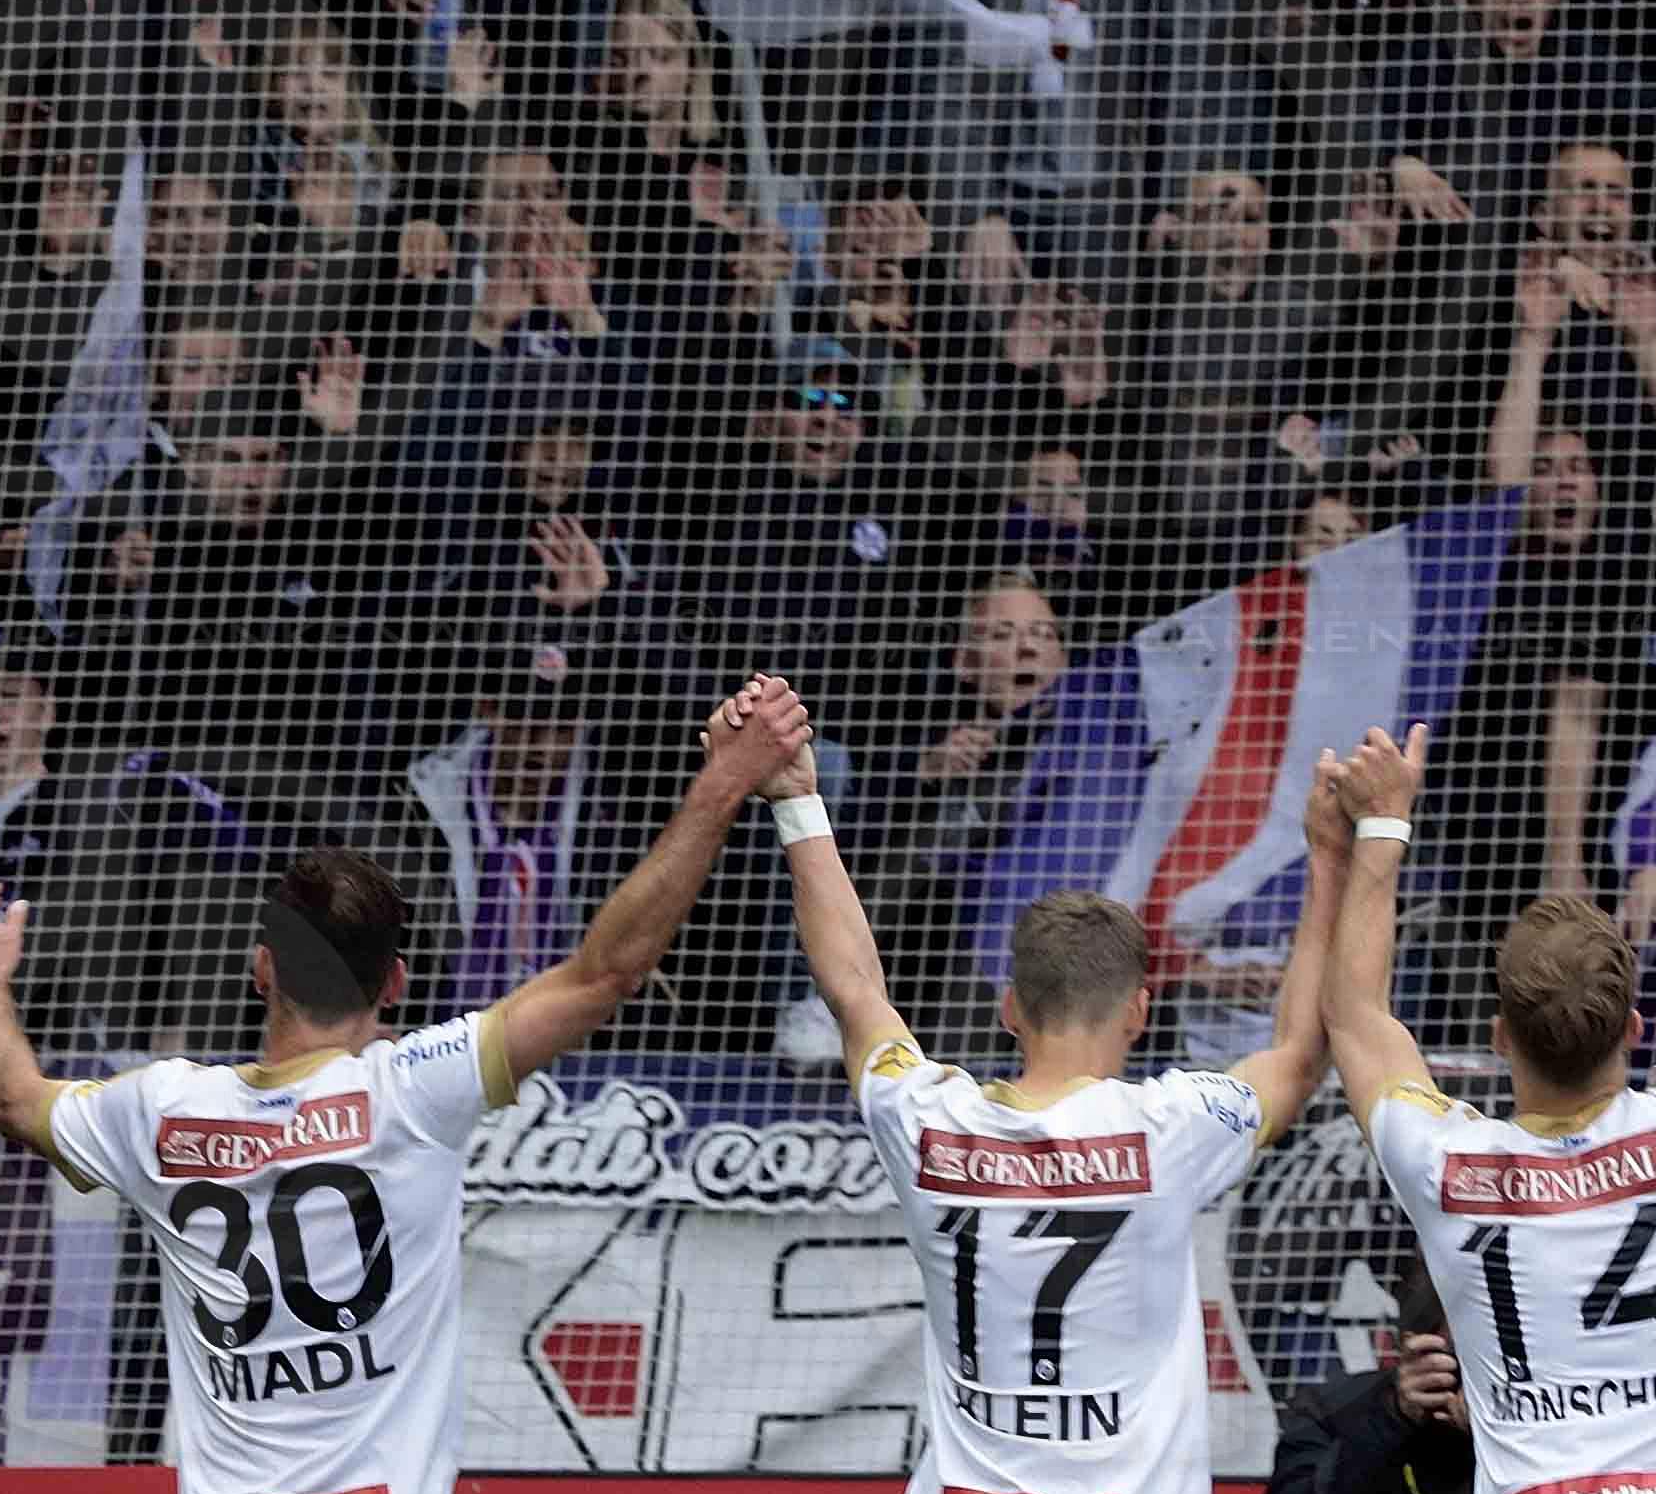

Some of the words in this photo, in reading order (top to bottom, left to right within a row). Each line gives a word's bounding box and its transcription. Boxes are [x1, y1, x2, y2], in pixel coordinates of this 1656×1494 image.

[203, 1104, 362, 1170] GENERALI
[966, 1144, 1142, 1190] GENERALI
[169, 1162, 393, 1351] 30
[935, 1209, 1135, 1388] 17
[207, 1332, 396, 1404] MADL
